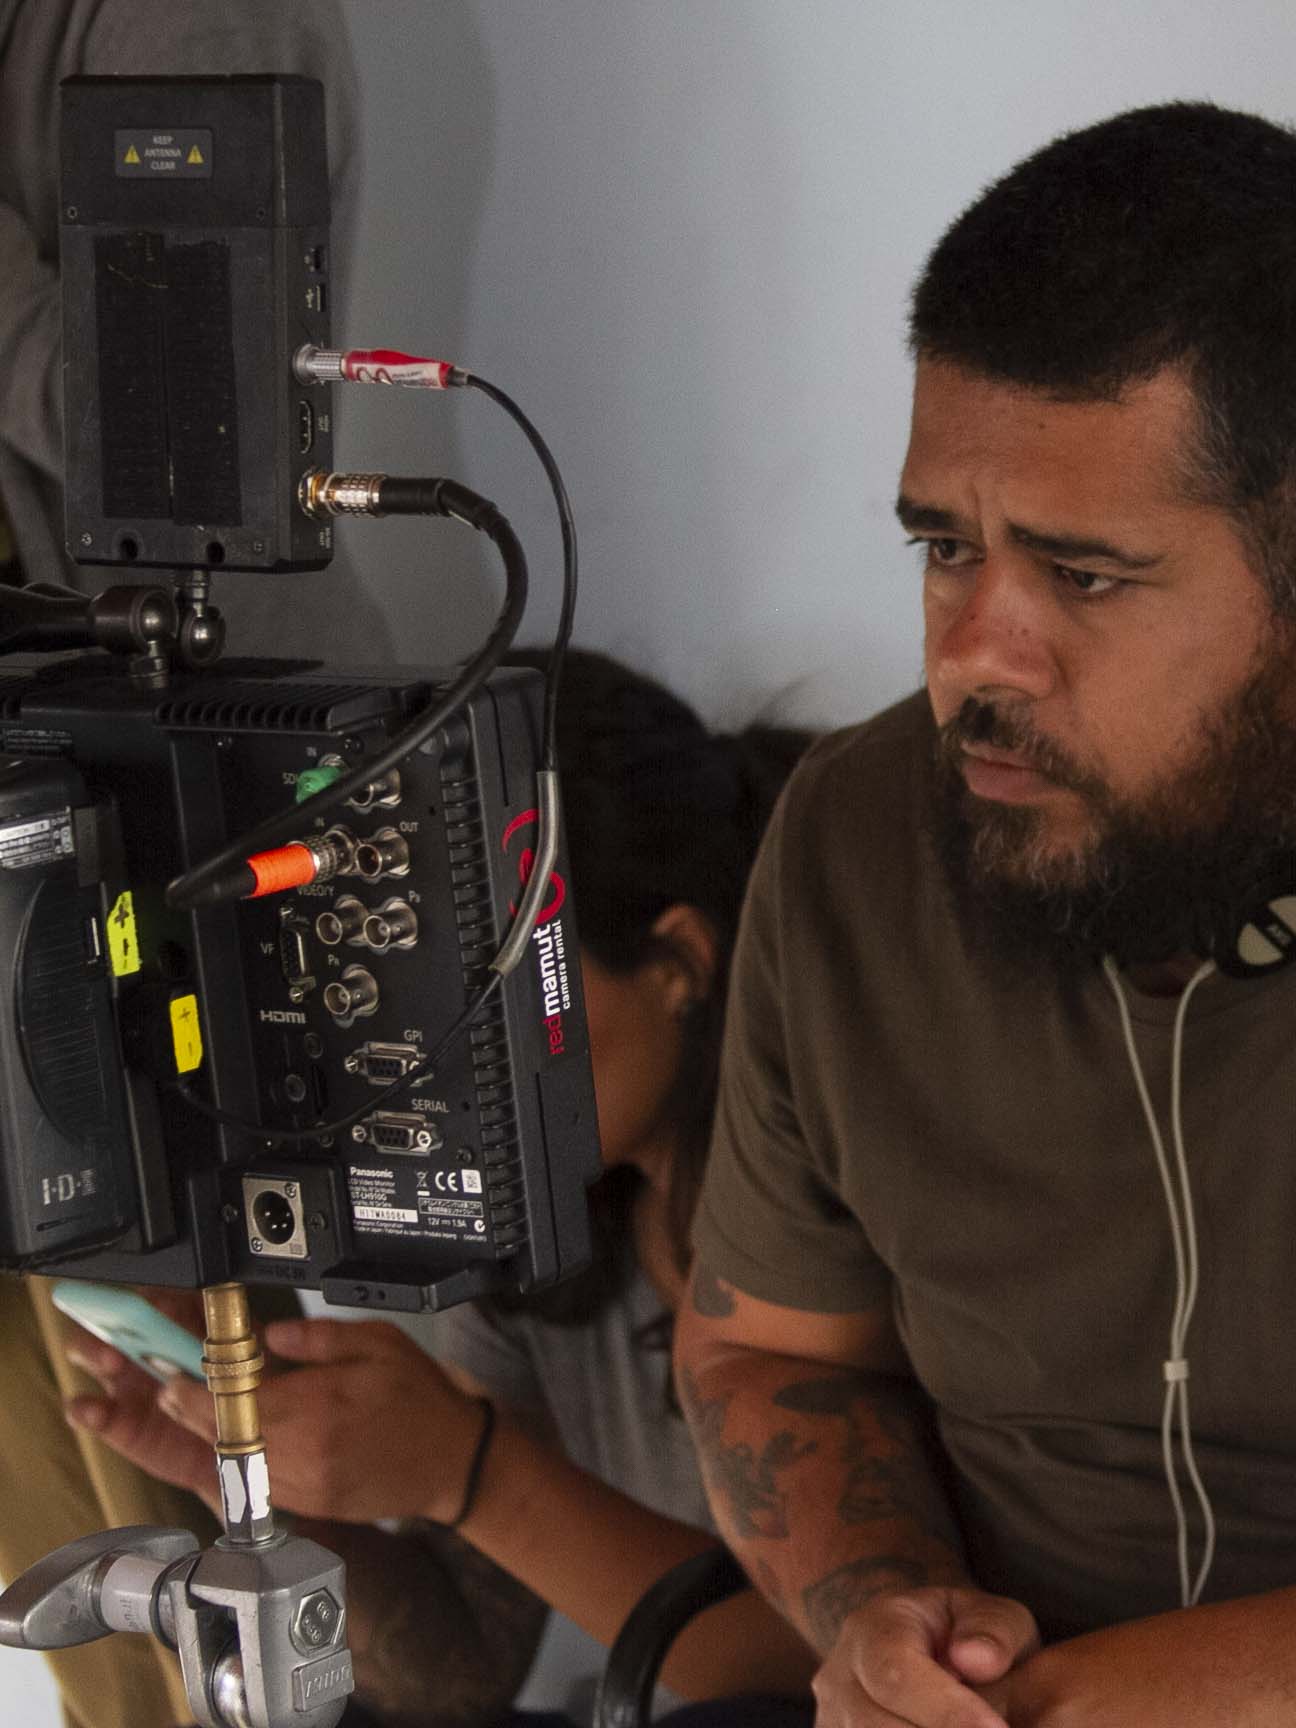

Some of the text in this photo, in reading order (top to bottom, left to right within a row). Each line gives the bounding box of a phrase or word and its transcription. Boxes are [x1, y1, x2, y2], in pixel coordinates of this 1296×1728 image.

[144, 148, 181, 157] ANTENNA
[151, 161, 175, 170] CLEAR
[399, 821, 419, 833] OUT
[260, 942, 275, 954] VF
[551, 919, 571, 1010] camera rental
[260, 1009, 306, 1024] HDMI
[404, 1029, 423, 1042] GPI
[411, 1098, 449, 1113] SERIAL
[350, 1166, 394, 1178] Panasonic
